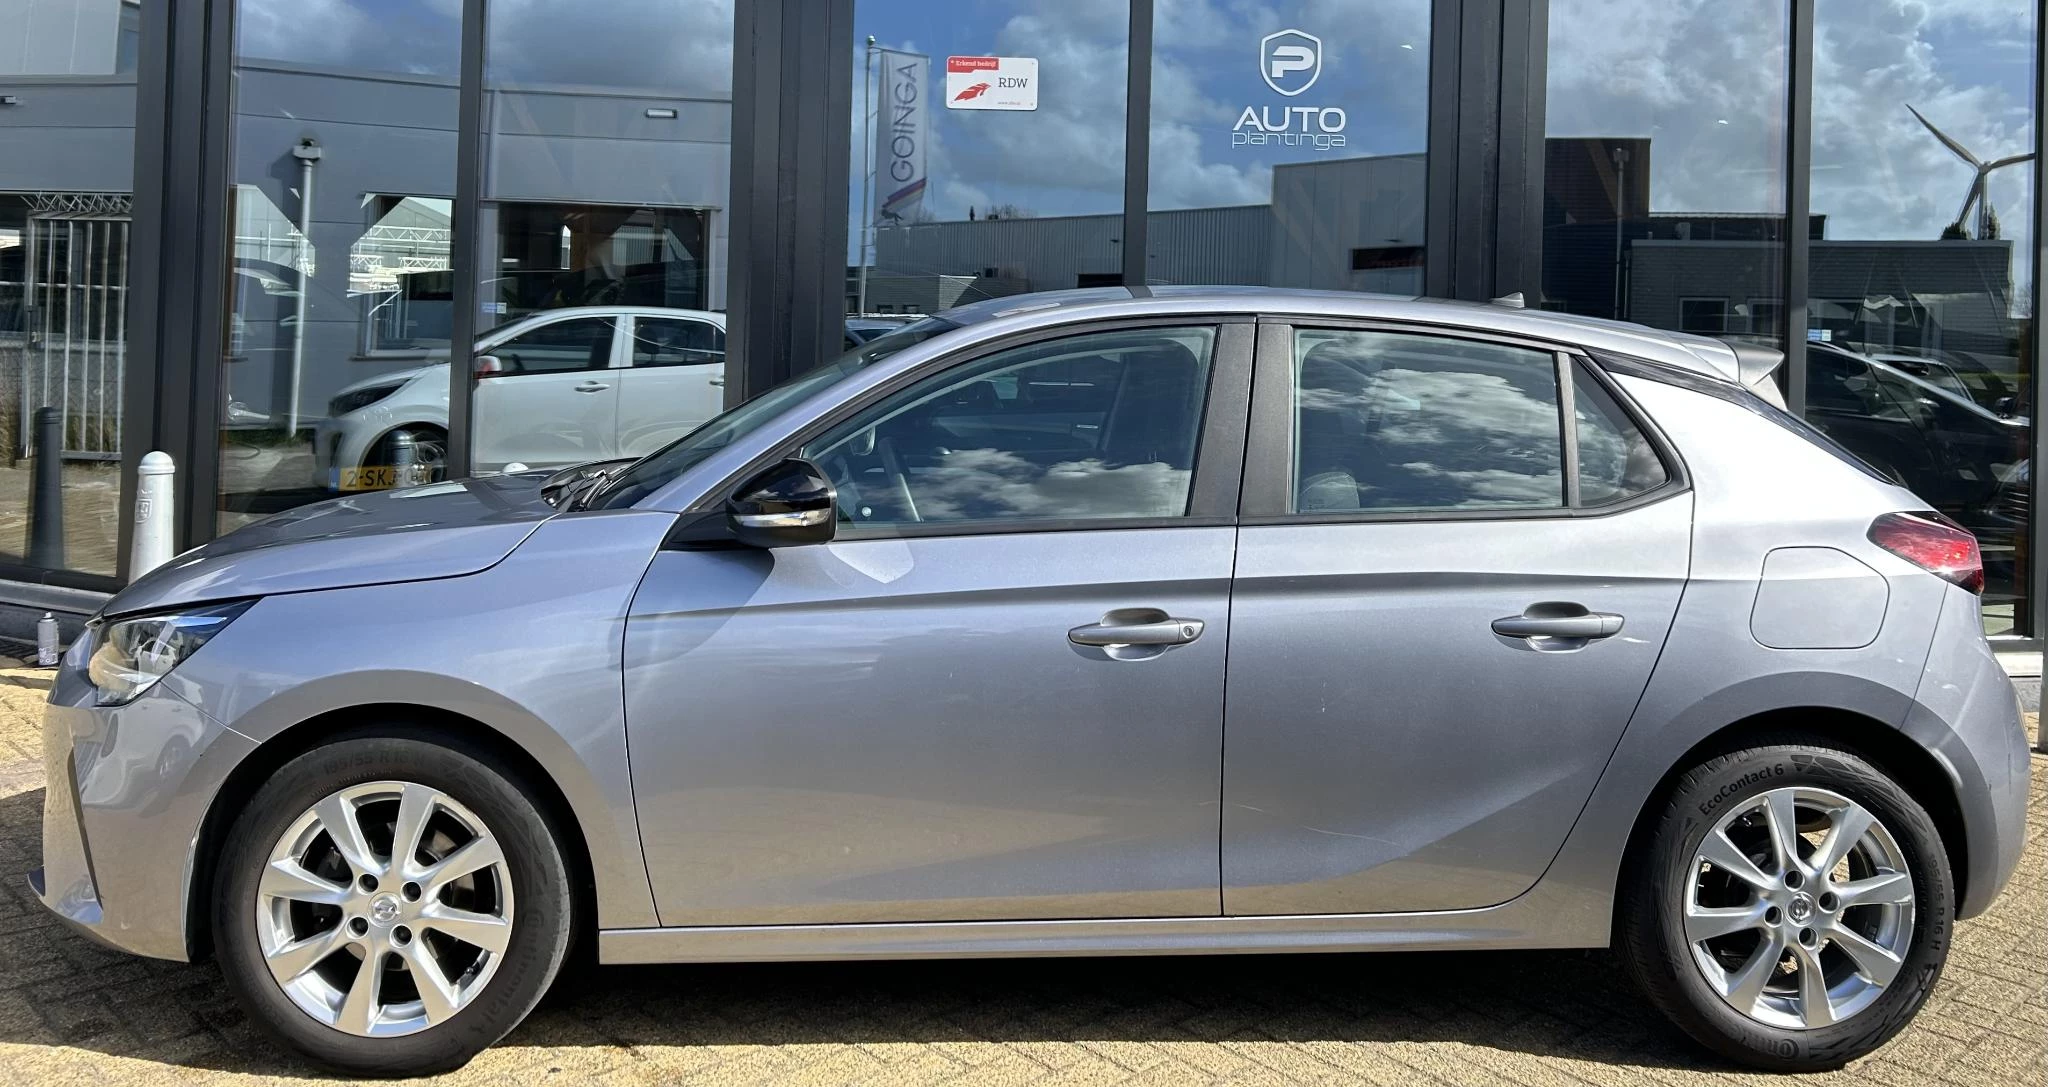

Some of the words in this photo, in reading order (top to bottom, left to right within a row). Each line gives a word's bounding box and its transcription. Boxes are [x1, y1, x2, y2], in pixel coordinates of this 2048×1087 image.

[998, 77, 1028, 88] RDW
[890, 63, 918, 182] GOINGA
[1232, 106, 1346, 133] AUTO
[1231, 130, 1346, 151] plantinga
[1699, 766, 1773, 816] EcoContact
[1774, 763, 1785, 776] 6
[1933, 920, 1945, 935] 16
[1930, 940, 1942, 951] H
